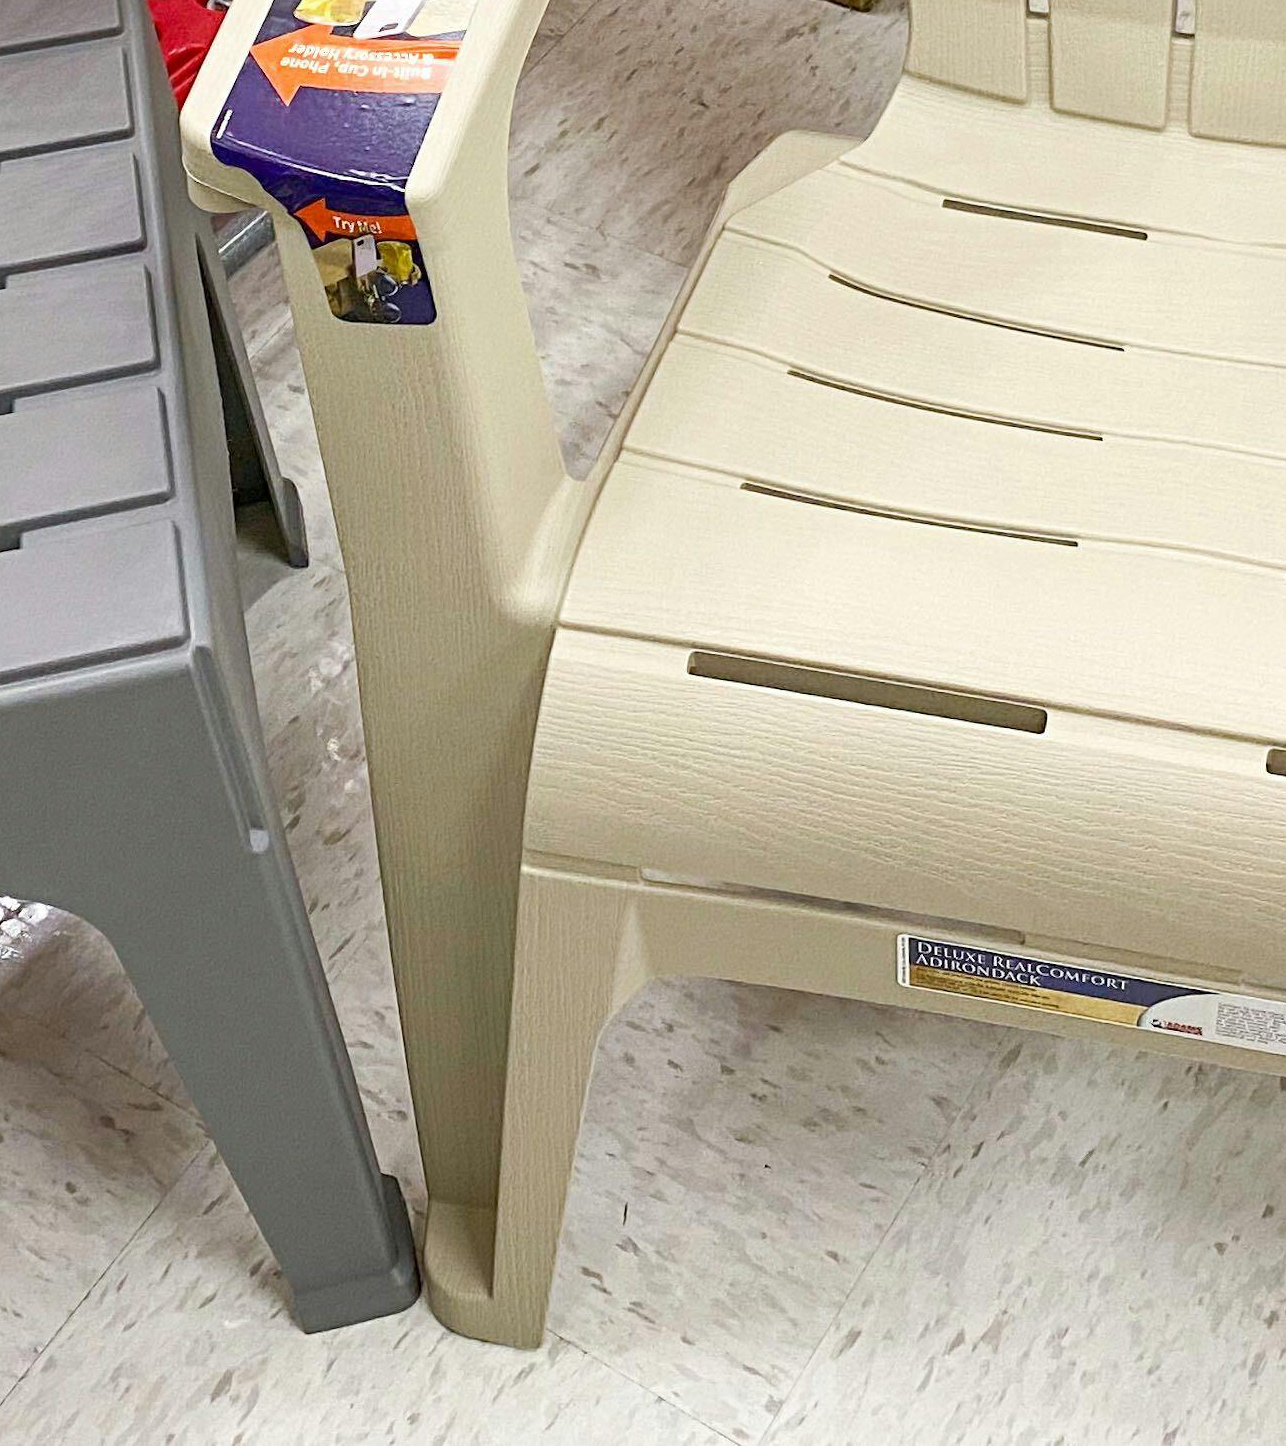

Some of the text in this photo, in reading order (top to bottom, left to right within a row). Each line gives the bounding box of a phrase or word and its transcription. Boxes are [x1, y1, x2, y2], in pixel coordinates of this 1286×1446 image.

[288, 43, 341, 60] Holder
[280, 56, 331, 74] Phone
[332, 215, 355, 233] Try
[915, 954, 1042, 987] ADIRONDACK
[917, 941, 986, 966] DELUXE
[992, 955, 1129, 991] REALCOMFORT
